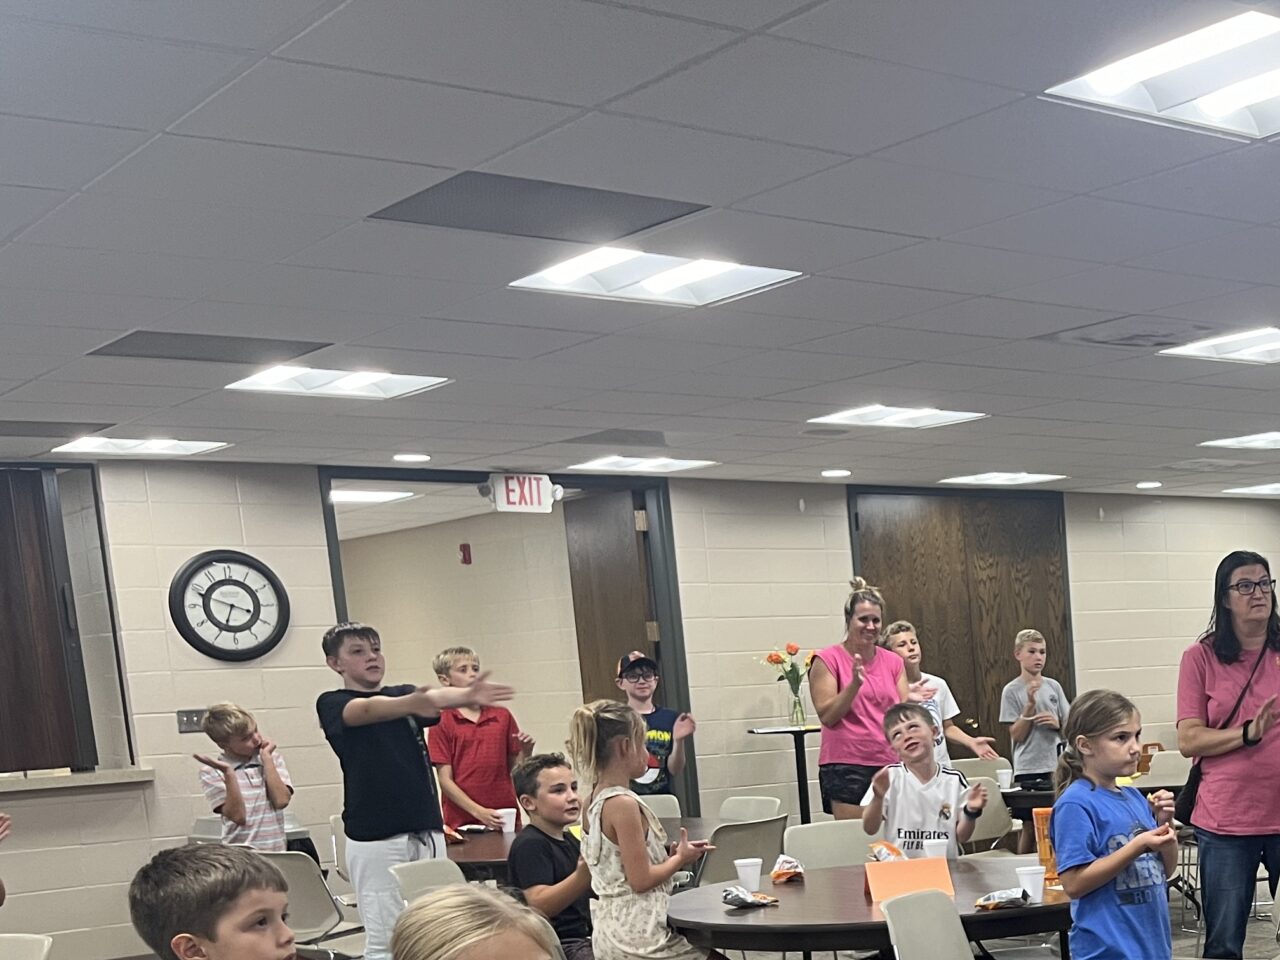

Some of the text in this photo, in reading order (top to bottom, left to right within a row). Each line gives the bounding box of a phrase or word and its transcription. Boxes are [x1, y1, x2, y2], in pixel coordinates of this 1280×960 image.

[504, 475, 543, 506] EXIT
[223, 565, 233, 579] 12
[897, 828, 949, 840] Emirates
[903, 840, 914, 850] FLY
